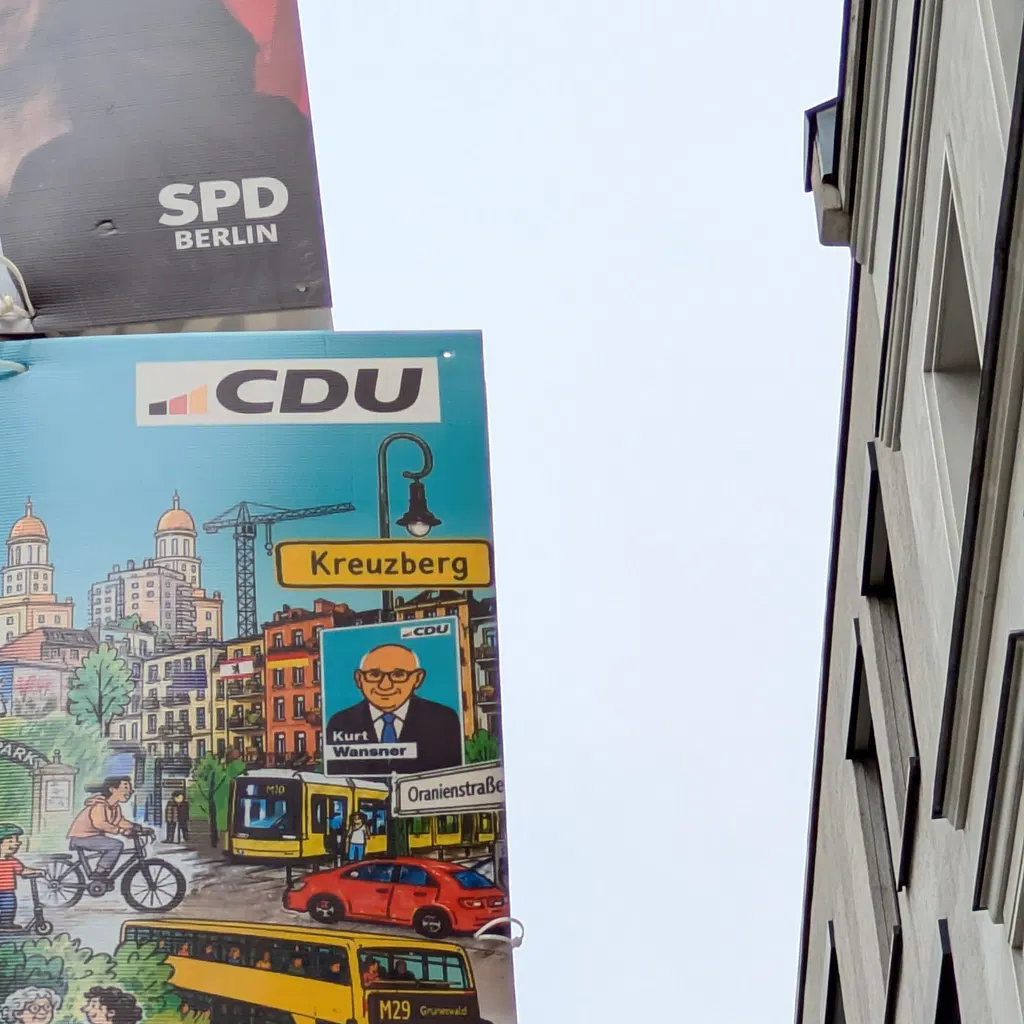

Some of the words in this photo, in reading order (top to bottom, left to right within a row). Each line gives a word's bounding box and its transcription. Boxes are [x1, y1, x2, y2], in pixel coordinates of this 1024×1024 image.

[158, 176, 289, 226] SPD
[175, 223, 278, 250] BERLIN
[215, 367, 423, 414] CDU
[310, 549, 469, 580] Kreuzberg
[413, 624, 449, 636] CDU
[333, 730, 369, 742] Kurt
[333, 745, 407, 758] Wansner
[408, 775, 504, 803] Oranienstraße
[379, 1000, 411, 1020] M29
